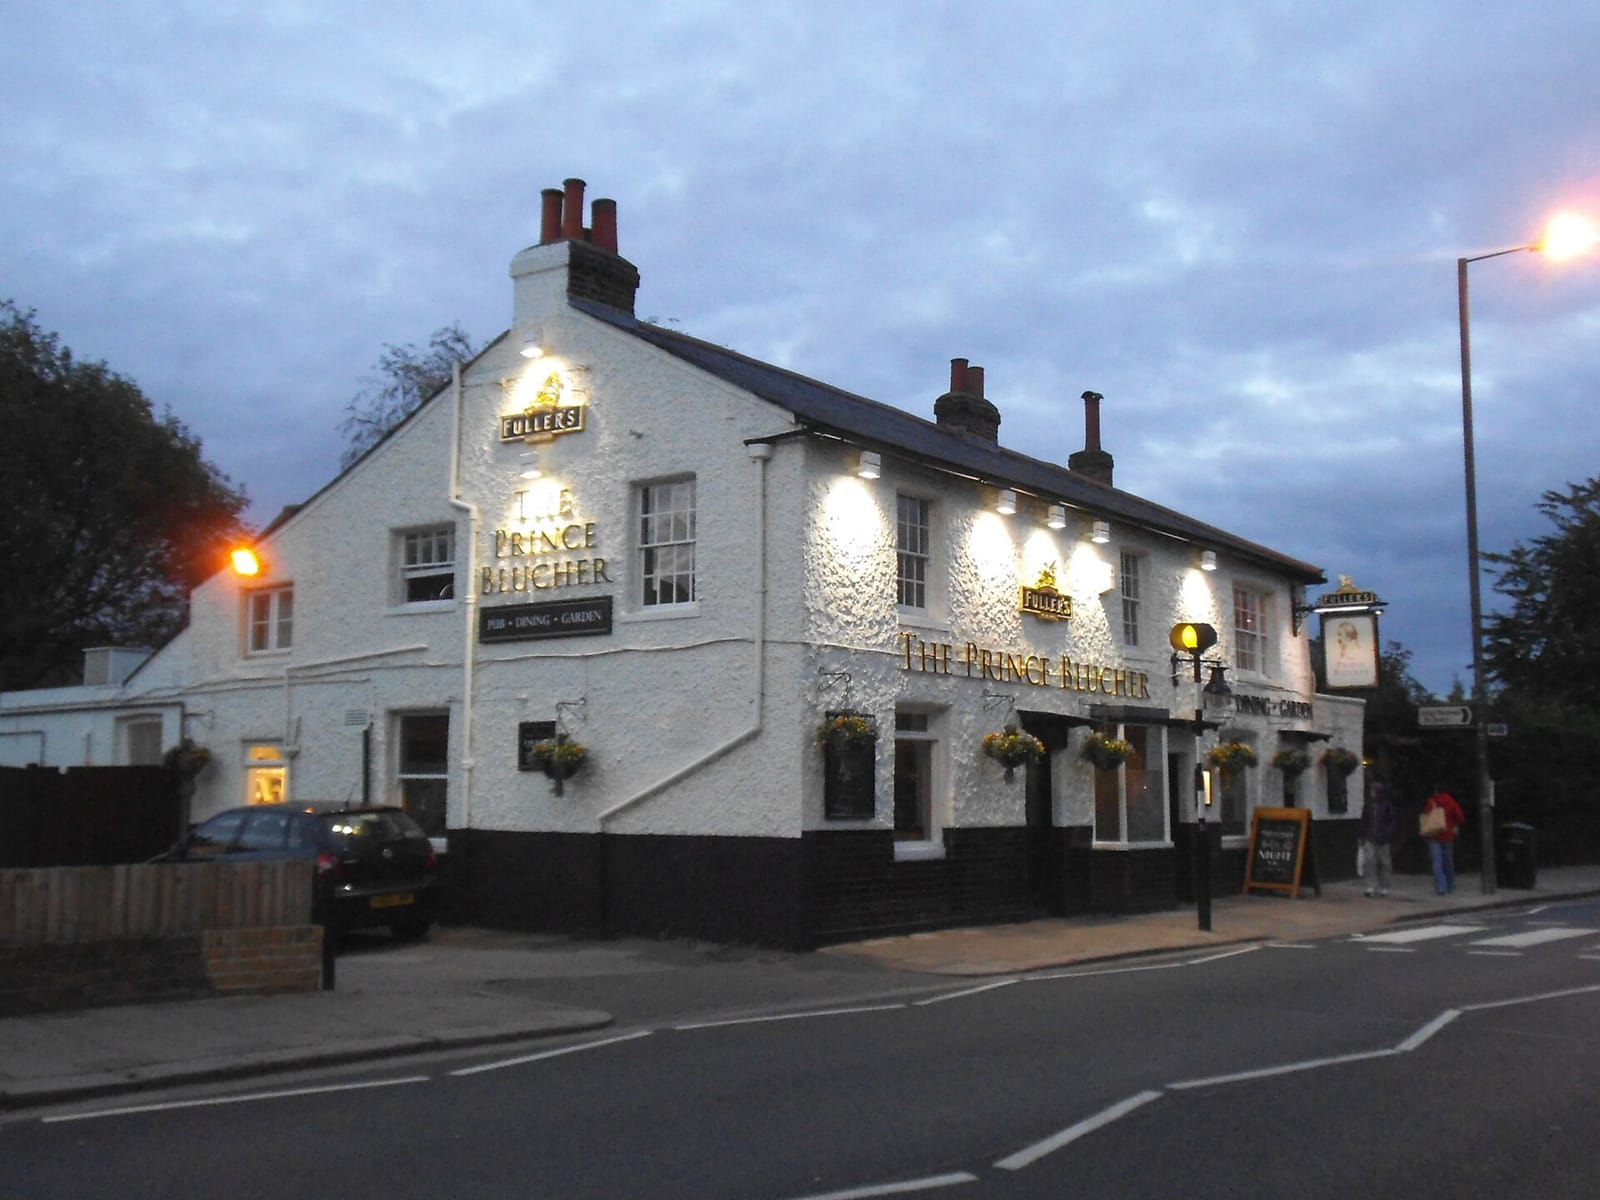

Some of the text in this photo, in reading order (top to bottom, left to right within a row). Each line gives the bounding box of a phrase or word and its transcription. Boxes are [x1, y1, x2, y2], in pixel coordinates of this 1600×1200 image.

[515, 488, 573, 523] TE
[494, 522, 599, 559] PRINCE
[480, 558, 614, 595] BLUCHER
[487, 610, 602, 630] PUB DINING GARDEN
[899, 631, 1151, 699] THE PRINCE BLUCHER
